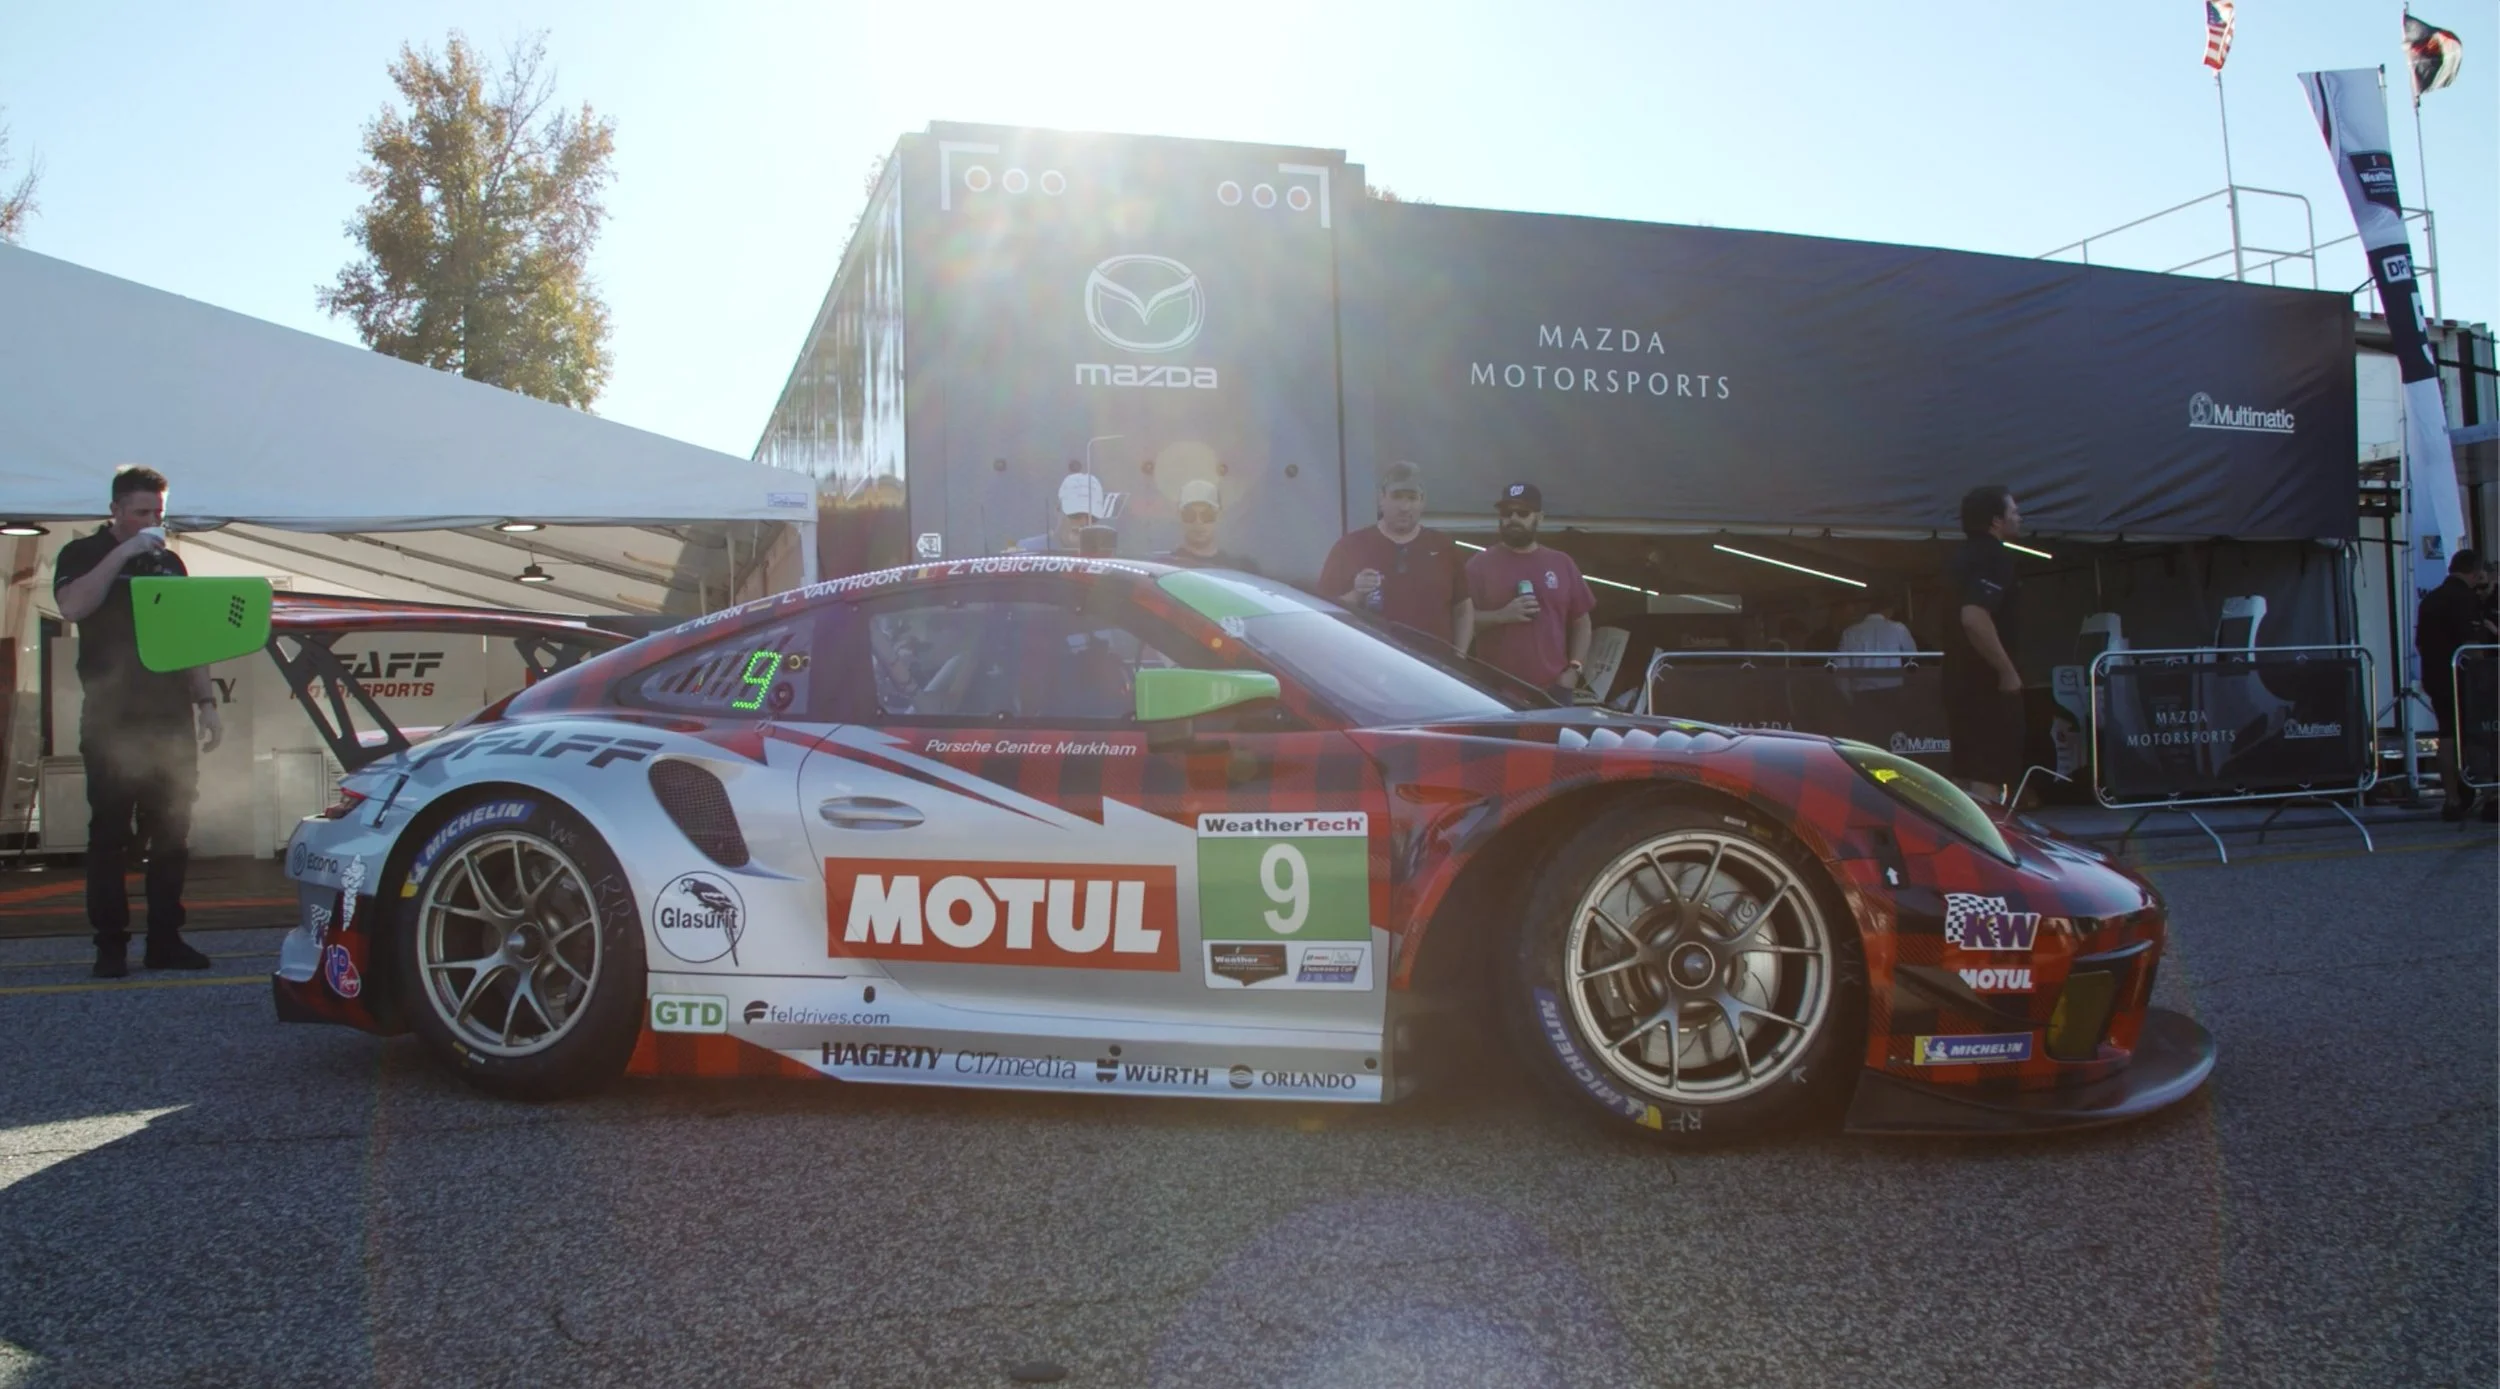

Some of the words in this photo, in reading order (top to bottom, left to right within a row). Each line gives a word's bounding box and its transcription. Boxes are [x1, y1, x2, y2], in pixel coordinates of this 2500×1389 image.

[1537, 324, 1666, 355] MAZDA
[1470, 362, 1731, 400] MOTORSPORTS
[2213, 403, 2295, 430] Multimatic
[948, 563, 964, 575] Z.
[970, 559, 1076, 574] ROBICHON
[781, 590, 797, 604] L.
[803, 569, 904, 600] VANTHOOR
[695, 605, 745, 629] KERN
[733, 650, 783, 710] 9
[2156, 710, 2208, 725] MAZDA
[925, 738, 991, 754] Porsche
[994, 740, 1052, 755] Centre
[1055, 741, 1137, 756] Markham
[2127, 729, 2236, 748] MOTORSPORTS
[425, 802, 525, 862] MICHELIN
[1204, 816, 1362, 832] WeatherTech
[1260, 843, 1310, 935] 9
[660, 907, 738, 930] Glasurit
[844, 873, 1162, 954] MOTUL
[1963, 913, 2039, 949] KW
[1959, 968, 2033, 990] MOTUL
[655, 1000, 724, 1027] GTD
[770, 1005, 891, 1026] feldrives.com
[821, 1041, 943, 1070] HAGERTY
[1539, 1000, 1623, 1105] MICHELIN
[1950, 1041, 2024, 1057] MICHELIN
[955, 1049, 1077, 1080] C17media
[1261, 1070, 1357, 1090] ORLANDO
